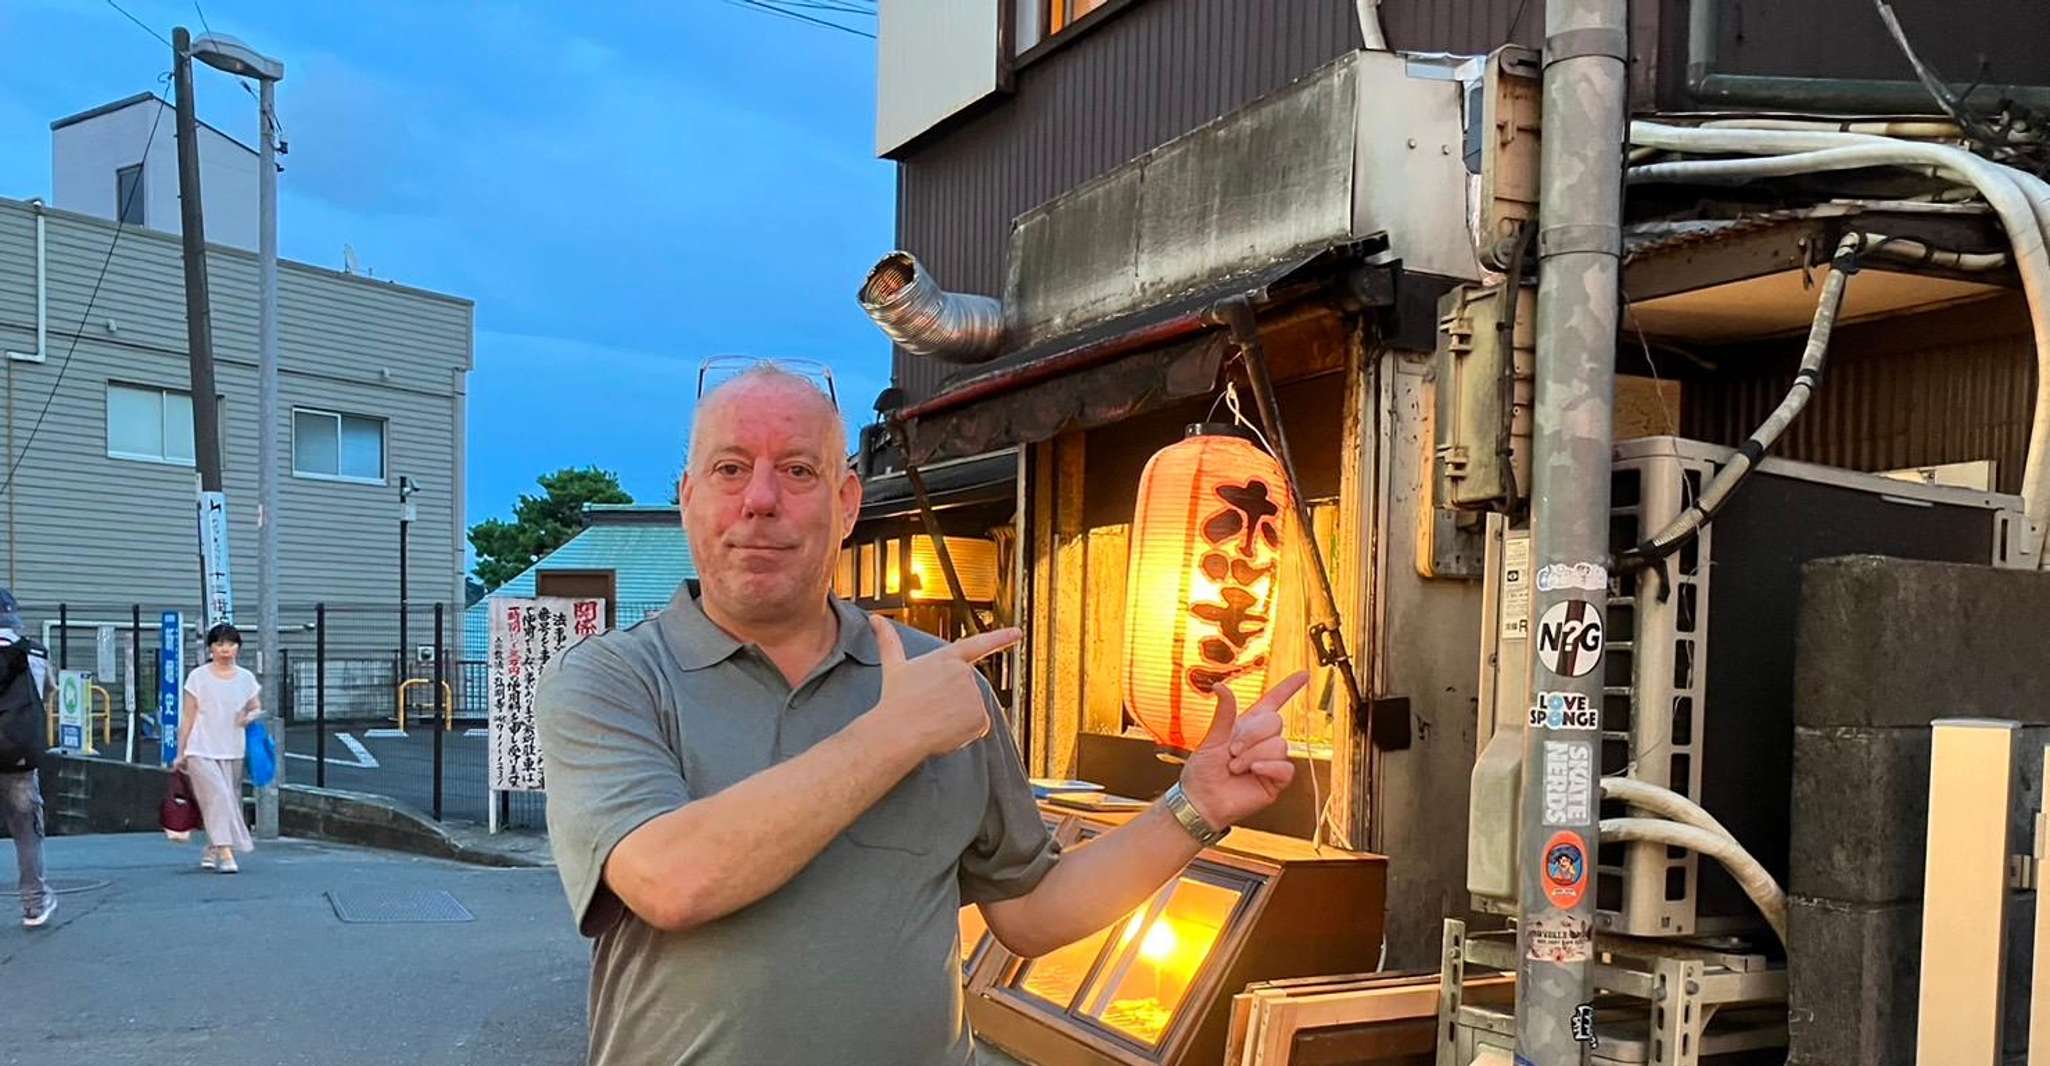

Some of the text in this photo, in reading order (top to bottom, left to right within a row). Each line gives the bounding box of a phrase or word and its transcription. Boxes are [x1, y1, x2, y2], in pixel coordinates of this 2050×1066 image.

[1530, 709, 1596, 728] SPONGE
[1539, 695, 1587, 710] LOVE
[1546, 742, 1568, 823] NERDS
[1568, 746, 1588, 819] SKATE
